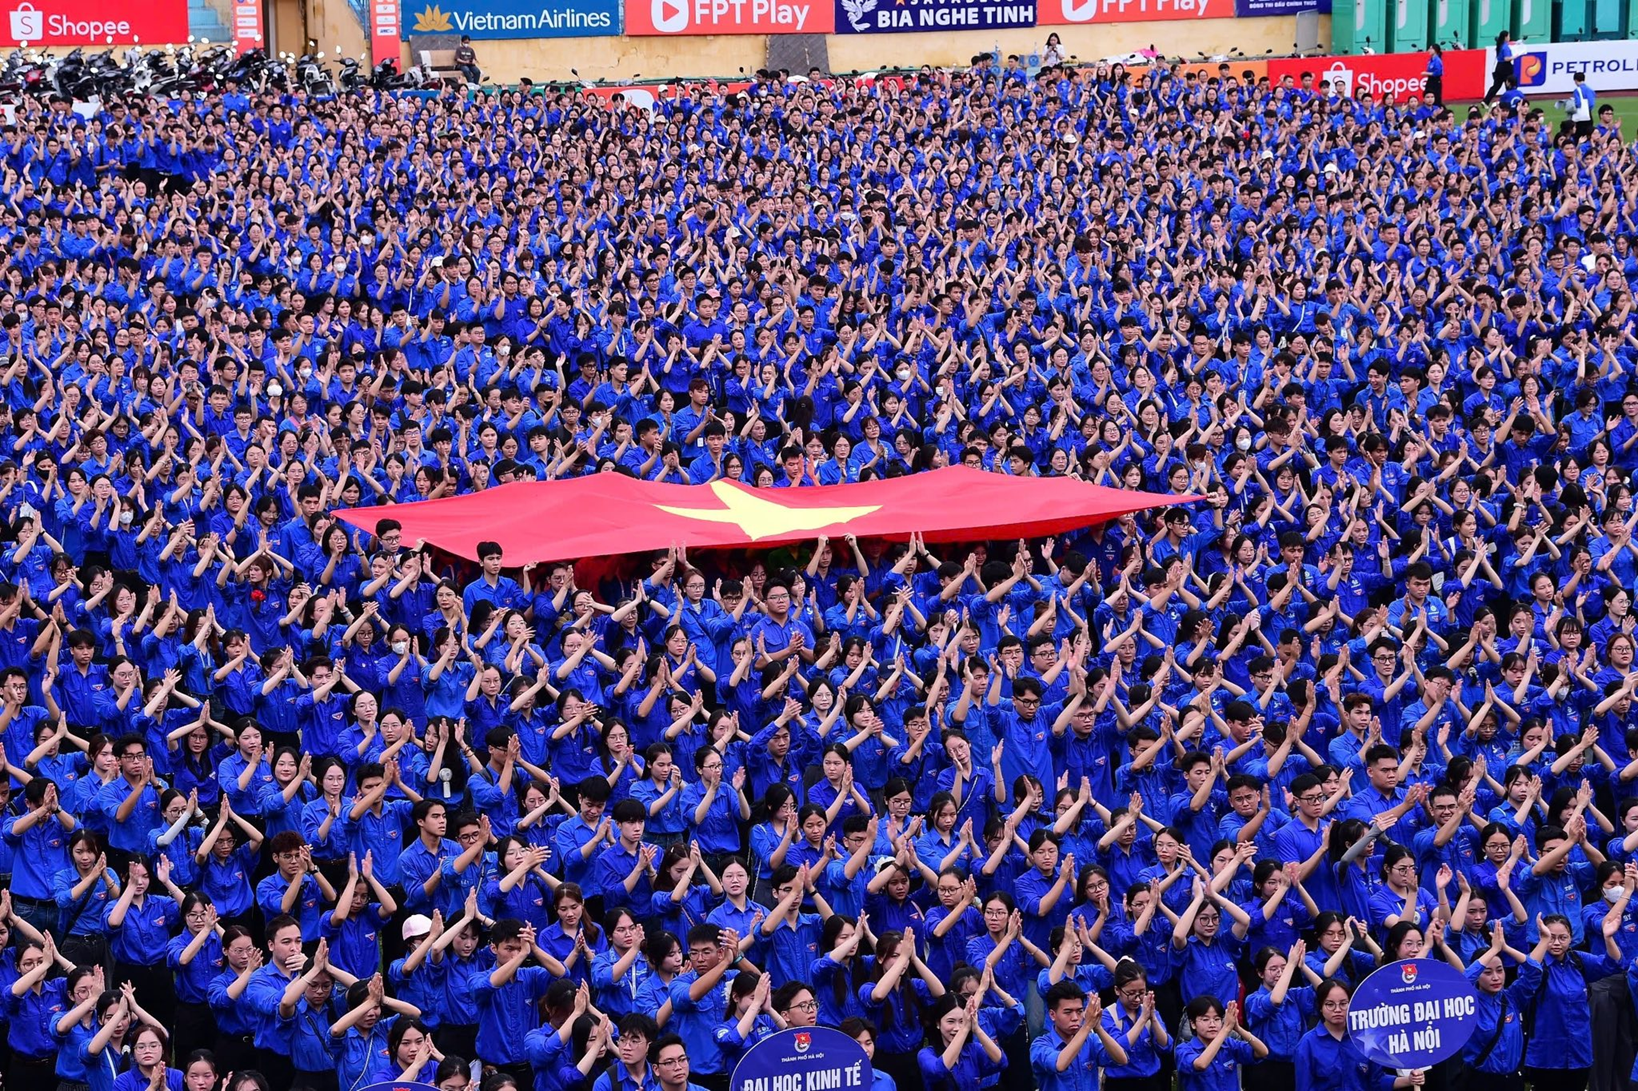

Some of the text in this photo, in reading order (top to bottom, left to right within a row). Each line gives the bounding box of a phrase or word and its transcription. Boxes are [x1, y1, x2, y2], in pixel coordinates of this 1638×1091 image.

[48, 14, 130, 41] Shopee
[453, 8, 611, 30] Vietnam Airlines
[695, 0, 810, 30] FPT Play
[877, 5, 1034, 28] BIA NGHE TINH
[1349, 995, 1475, 1031] TRƯỜNG ĐẠI HỌC
[1388, 1025, 1441, 1055] HÀ NỘI
[806, 1068, 841, 1091] KINH
[844, 1059, 862, 1087] TẾ
